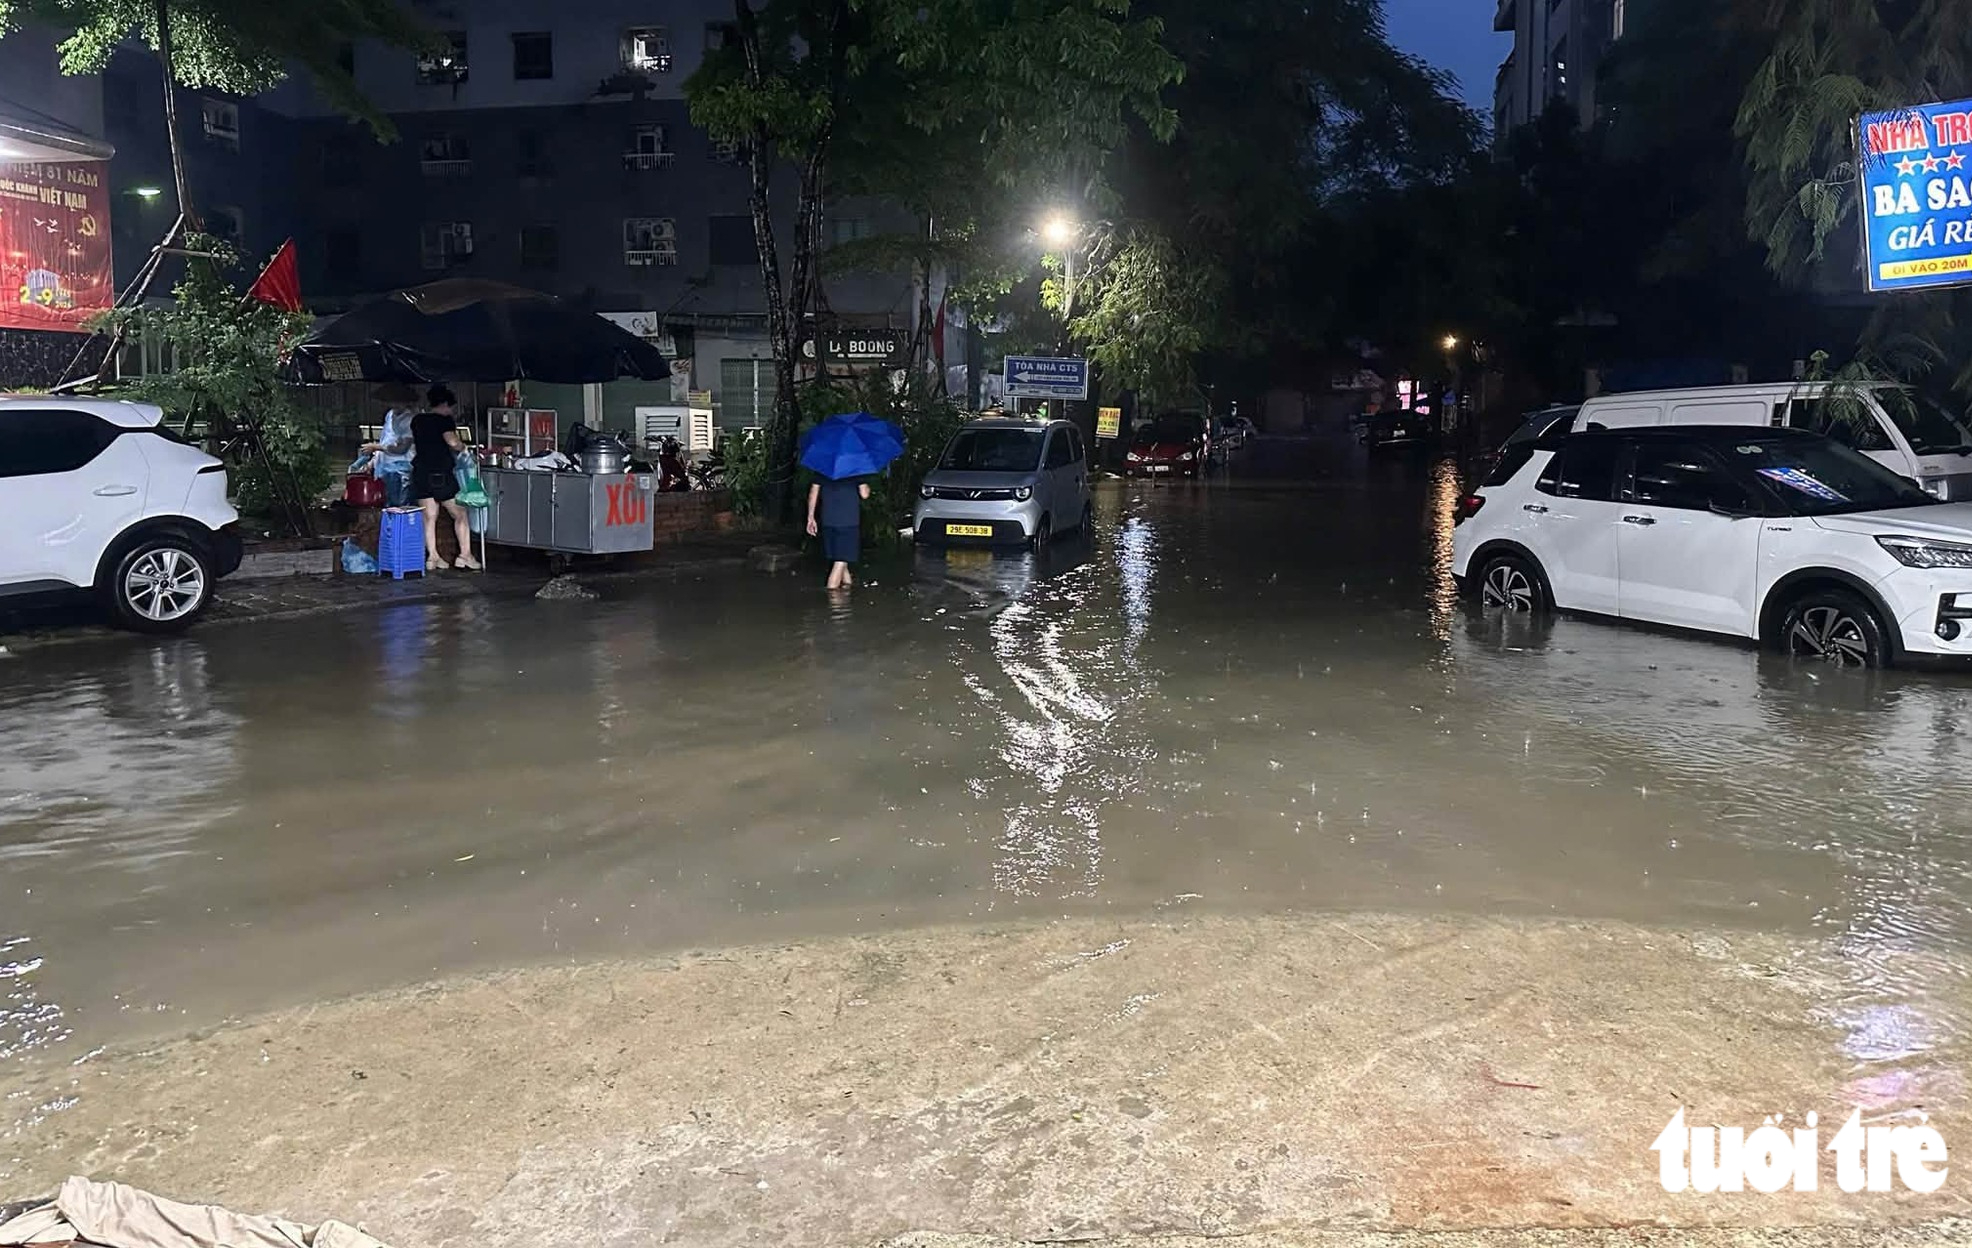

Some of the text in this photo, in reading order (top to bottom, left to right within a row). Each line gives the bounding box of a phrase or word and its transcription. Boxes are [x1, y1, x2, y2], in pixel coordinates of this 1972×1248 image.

[67, 168, 98, 187] NĂM
[40, 187, 61, 208] VIỆT
[64, 191, 87, 211] NAM
[1873, 175, 1972, 217] BA SA
[1888, 218, 1936, 250] GIÁ
[1941, 258, 1968, 270] 20M
[849, 341, 895, 353] BOONG
